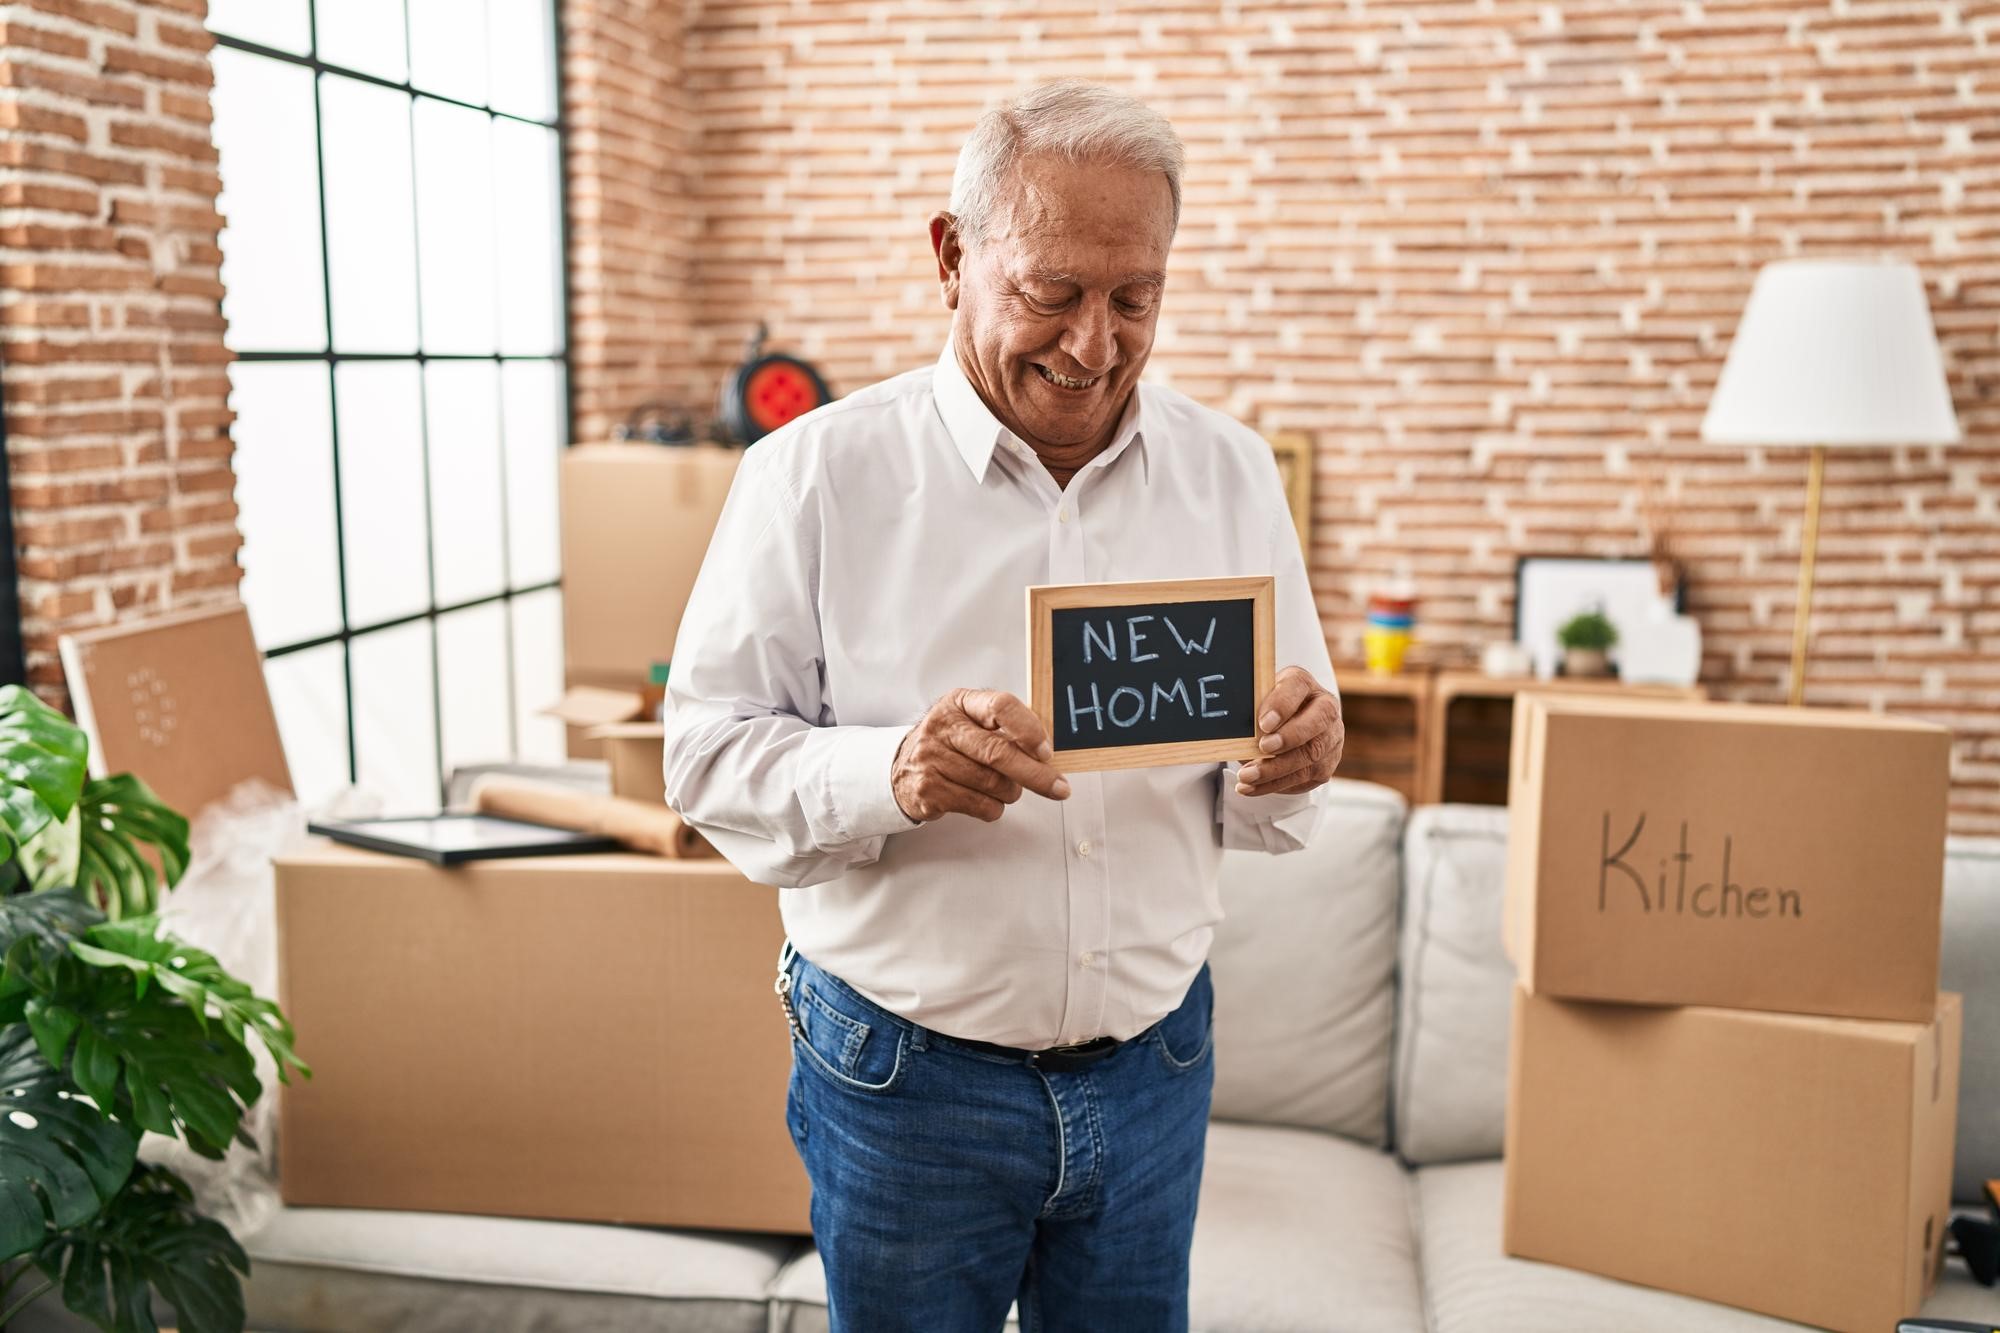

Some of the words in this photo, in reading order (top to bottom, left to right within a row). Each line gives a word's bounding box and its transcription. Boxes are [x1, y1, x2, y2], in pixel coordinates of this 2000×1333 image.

[1083, 615, 1216, 664] NEW
[1067, 674, 1228, 733] HOME
[1598, 811, 1802, 919] Kitchen
